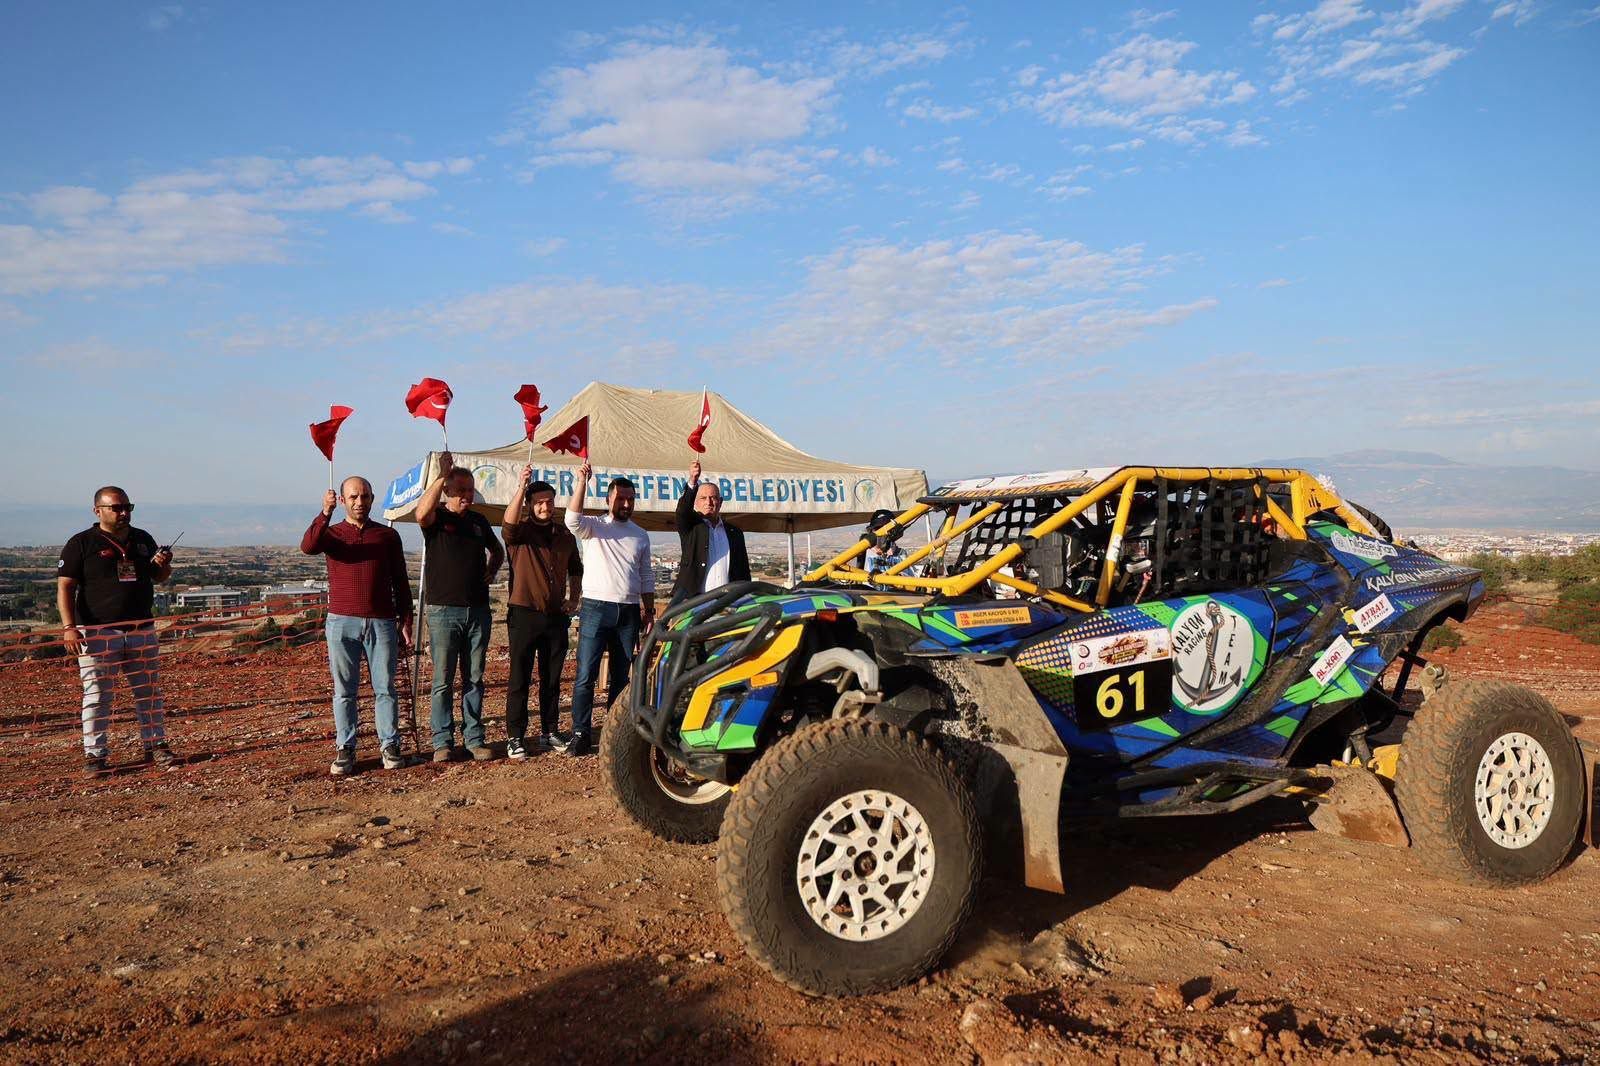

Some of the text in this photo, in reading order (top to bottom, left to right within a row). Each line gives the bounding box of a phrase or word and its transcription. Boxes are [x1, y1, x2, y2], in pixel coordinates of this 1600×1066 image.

[1366, 570, 1413, 592] KALYON
[1360, 600, 1386, 623] AYBAY
[1171, 612, 1206, 654] KALYON
[1183, 629, 1207, 656] RACING
[1316, 651, 1342, 680] AL-KAN
[1096, 670, 1145, 719] 61
